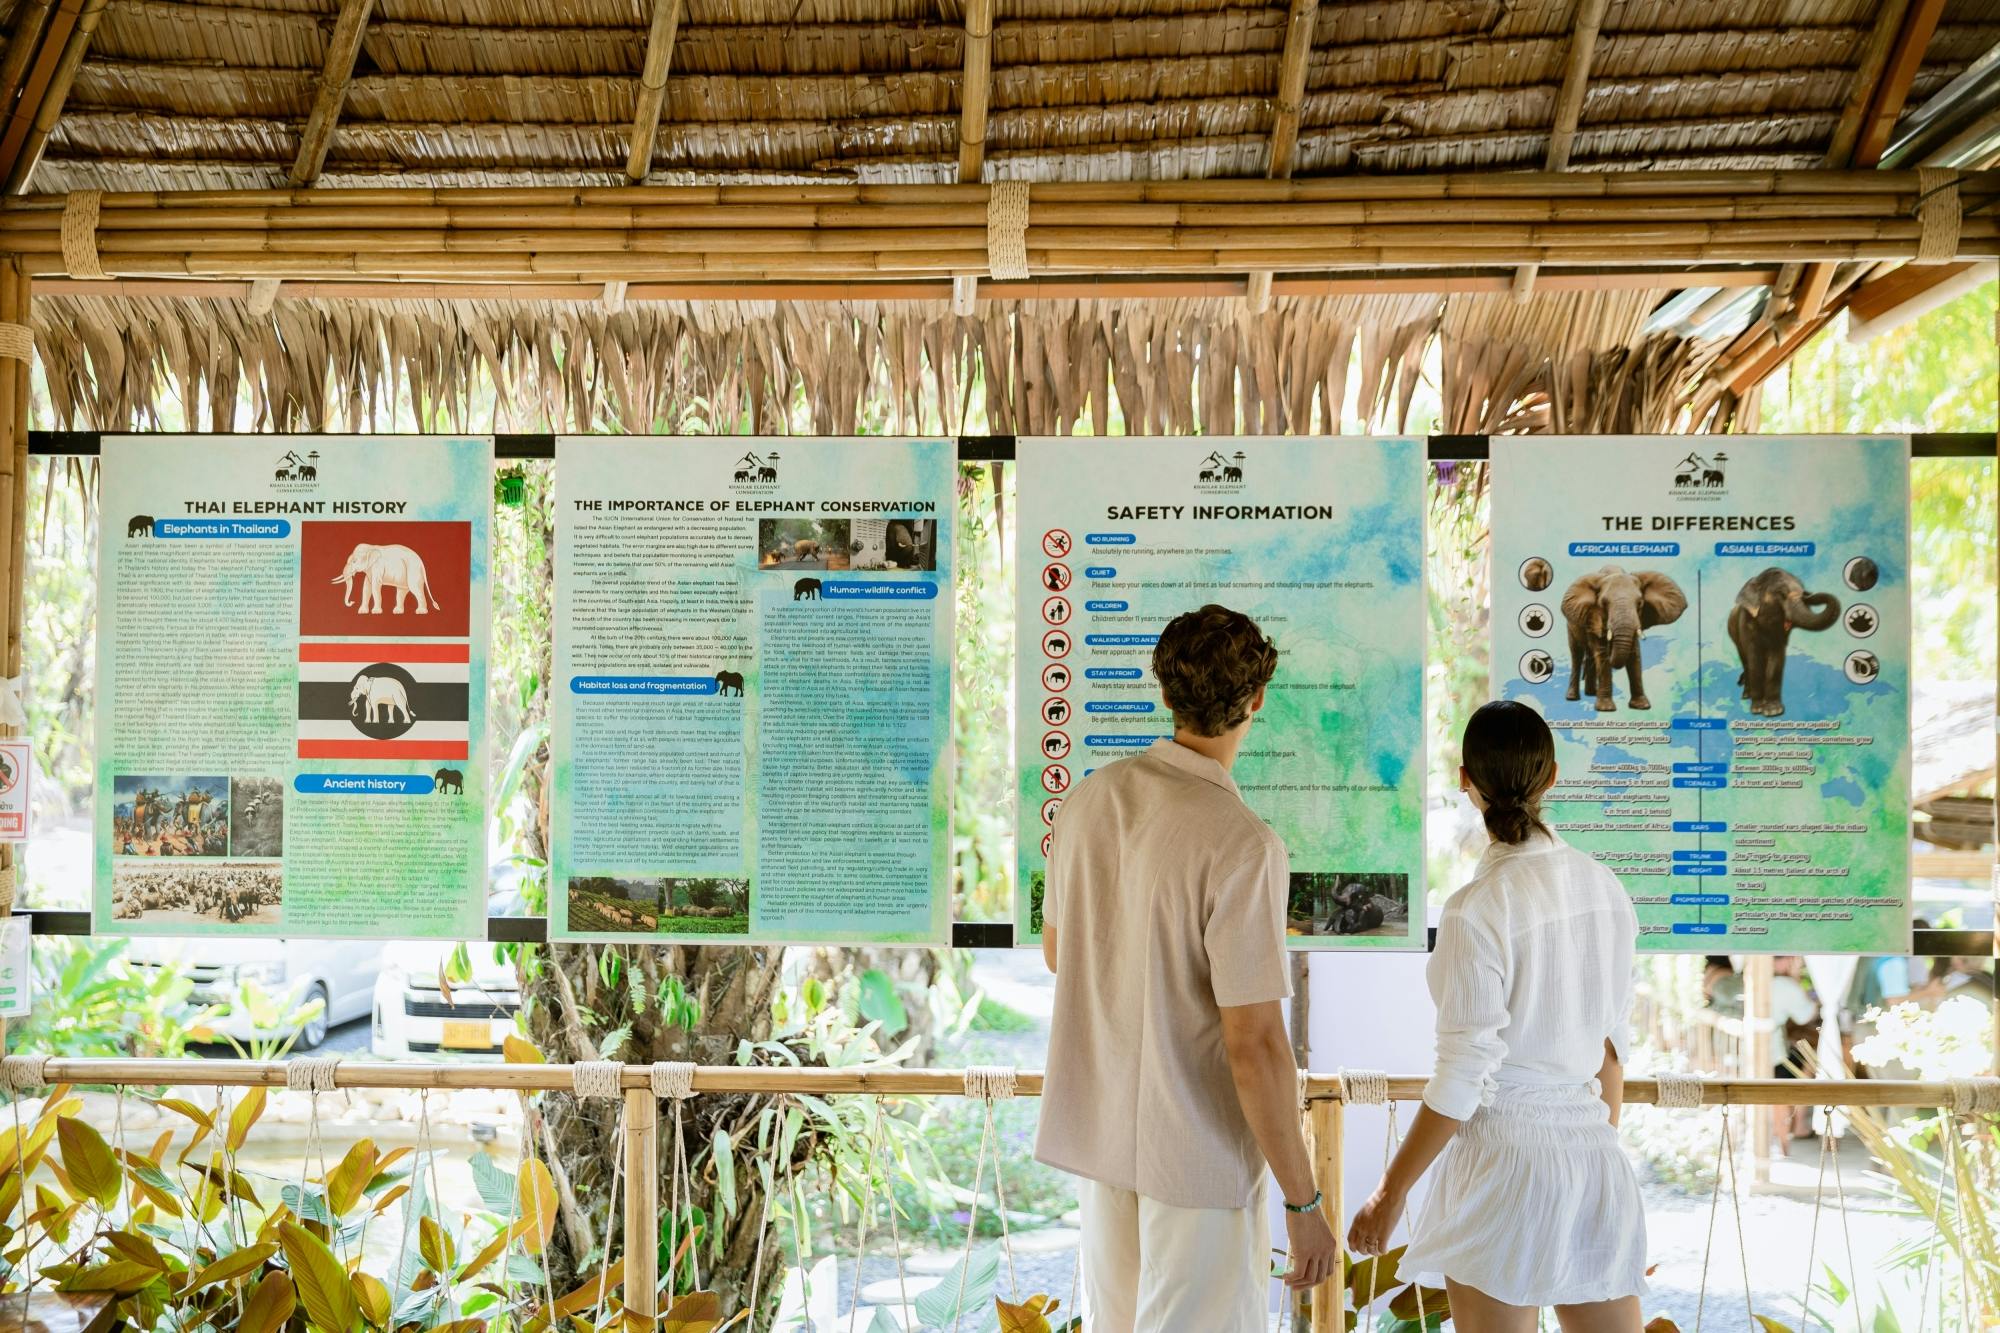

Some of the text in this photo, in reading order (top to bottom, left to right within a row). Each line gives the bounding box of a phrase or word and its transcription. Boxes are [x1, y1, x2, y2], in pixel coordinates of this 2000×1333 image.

[184, 502, 407, 514] THAI ELEPHANT HISTORY
[574, 501, 936, 512] THE IMPORTANCE OF ELEPHANT CONSERVATION
[1107, 506, 1332, 520] SAFETY INFORMATION
[1602, 516, 1796, 530] THE DIFFERENCES
[164, 524, 278, 536] Elephants in Thailand
[1574, 545, 1674, 554] AFRICAN ELEPHANT
[1722, 545, 1809, 554] ASIAN ELEPHANT
[830, 585, 926, 595] Human-wildlife conflict
[580, 681, 707, 692] Habitat loss and fragmentation
[324, 778, 406, 790] Ancient history
